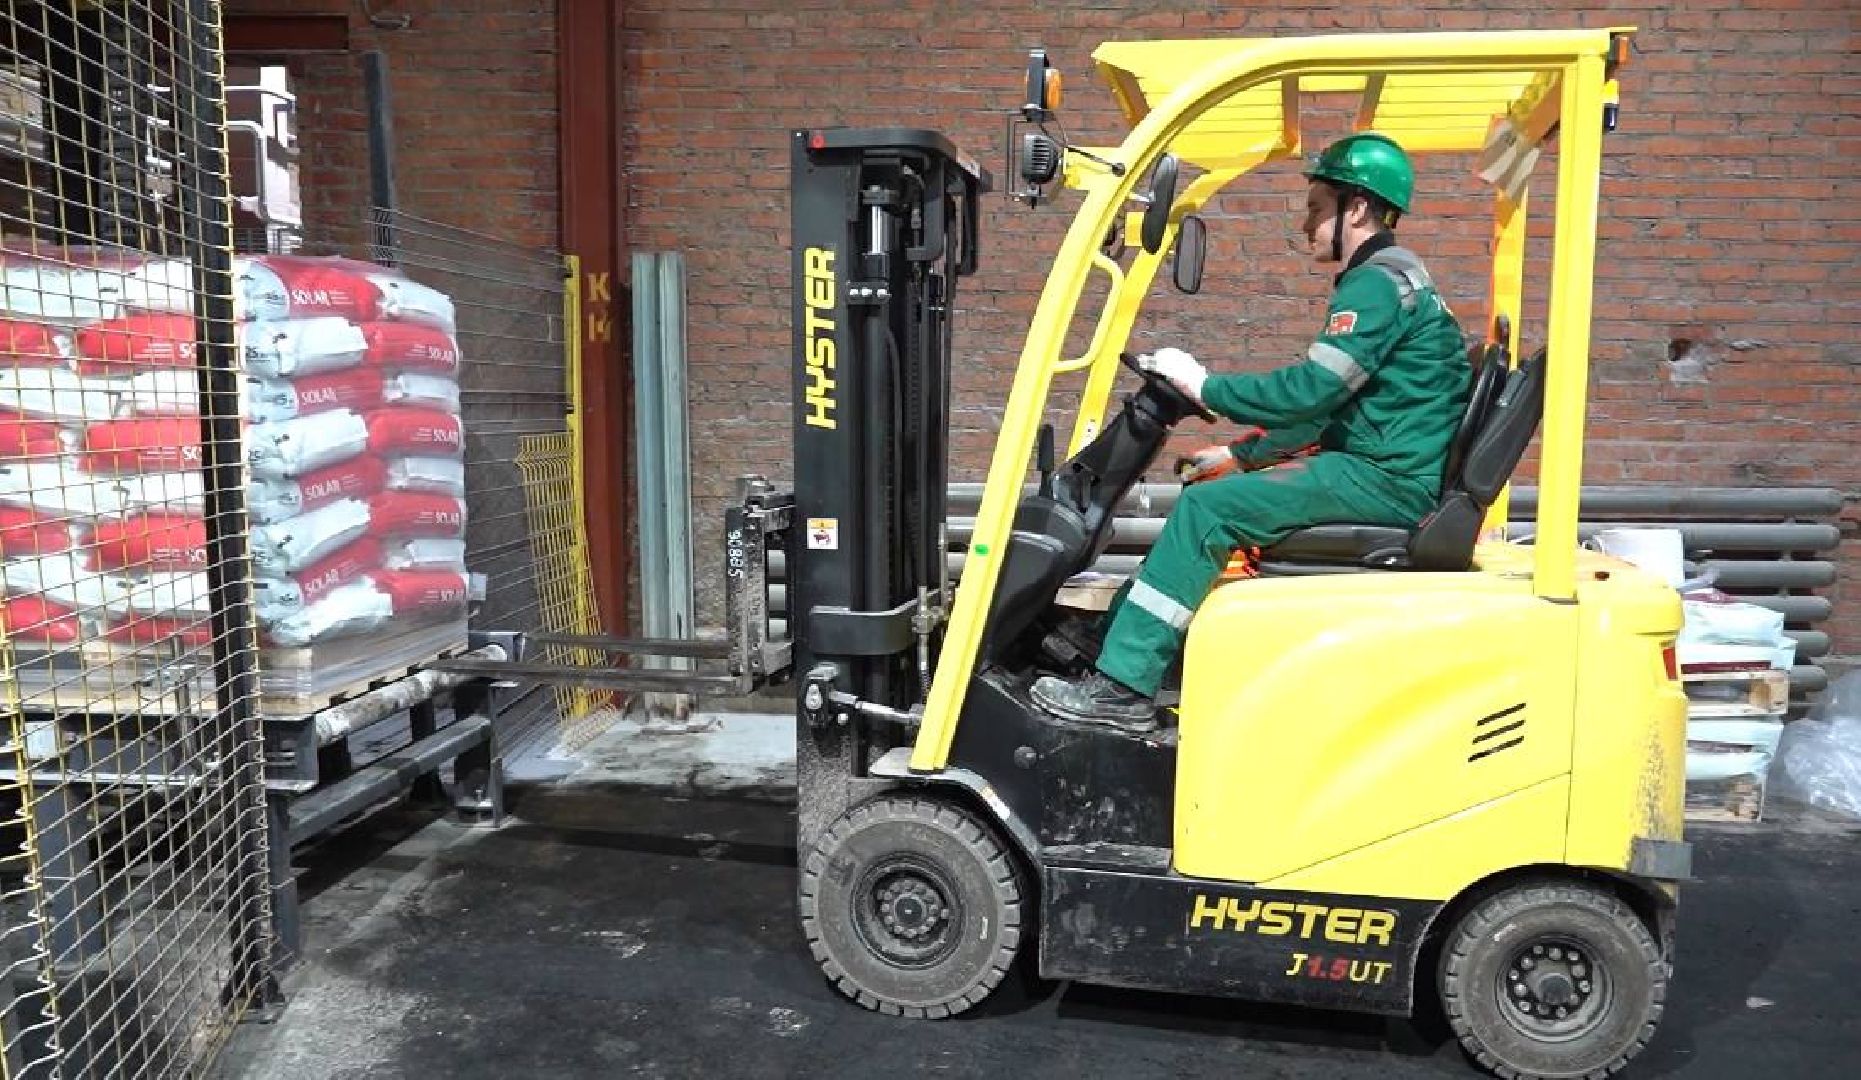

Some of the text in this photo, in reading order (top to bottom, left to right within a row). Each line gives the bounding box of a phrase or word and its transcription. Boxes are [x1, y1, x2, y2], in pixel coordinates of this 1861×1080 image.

[291, 289, 331, 306] SOLAR
[806, 246, 836, 430] HYSTER
[301, 386, 338, 406] SOLAR
[433, 428, 459, 446] SOLAR
[304, 479, 341, 501] SOLAR
[304, 568, 340, 597] SOLAR
[1190, 894, 1397, 946] HYSTER
[1285, 952, 1393, 984] J1.5UT
